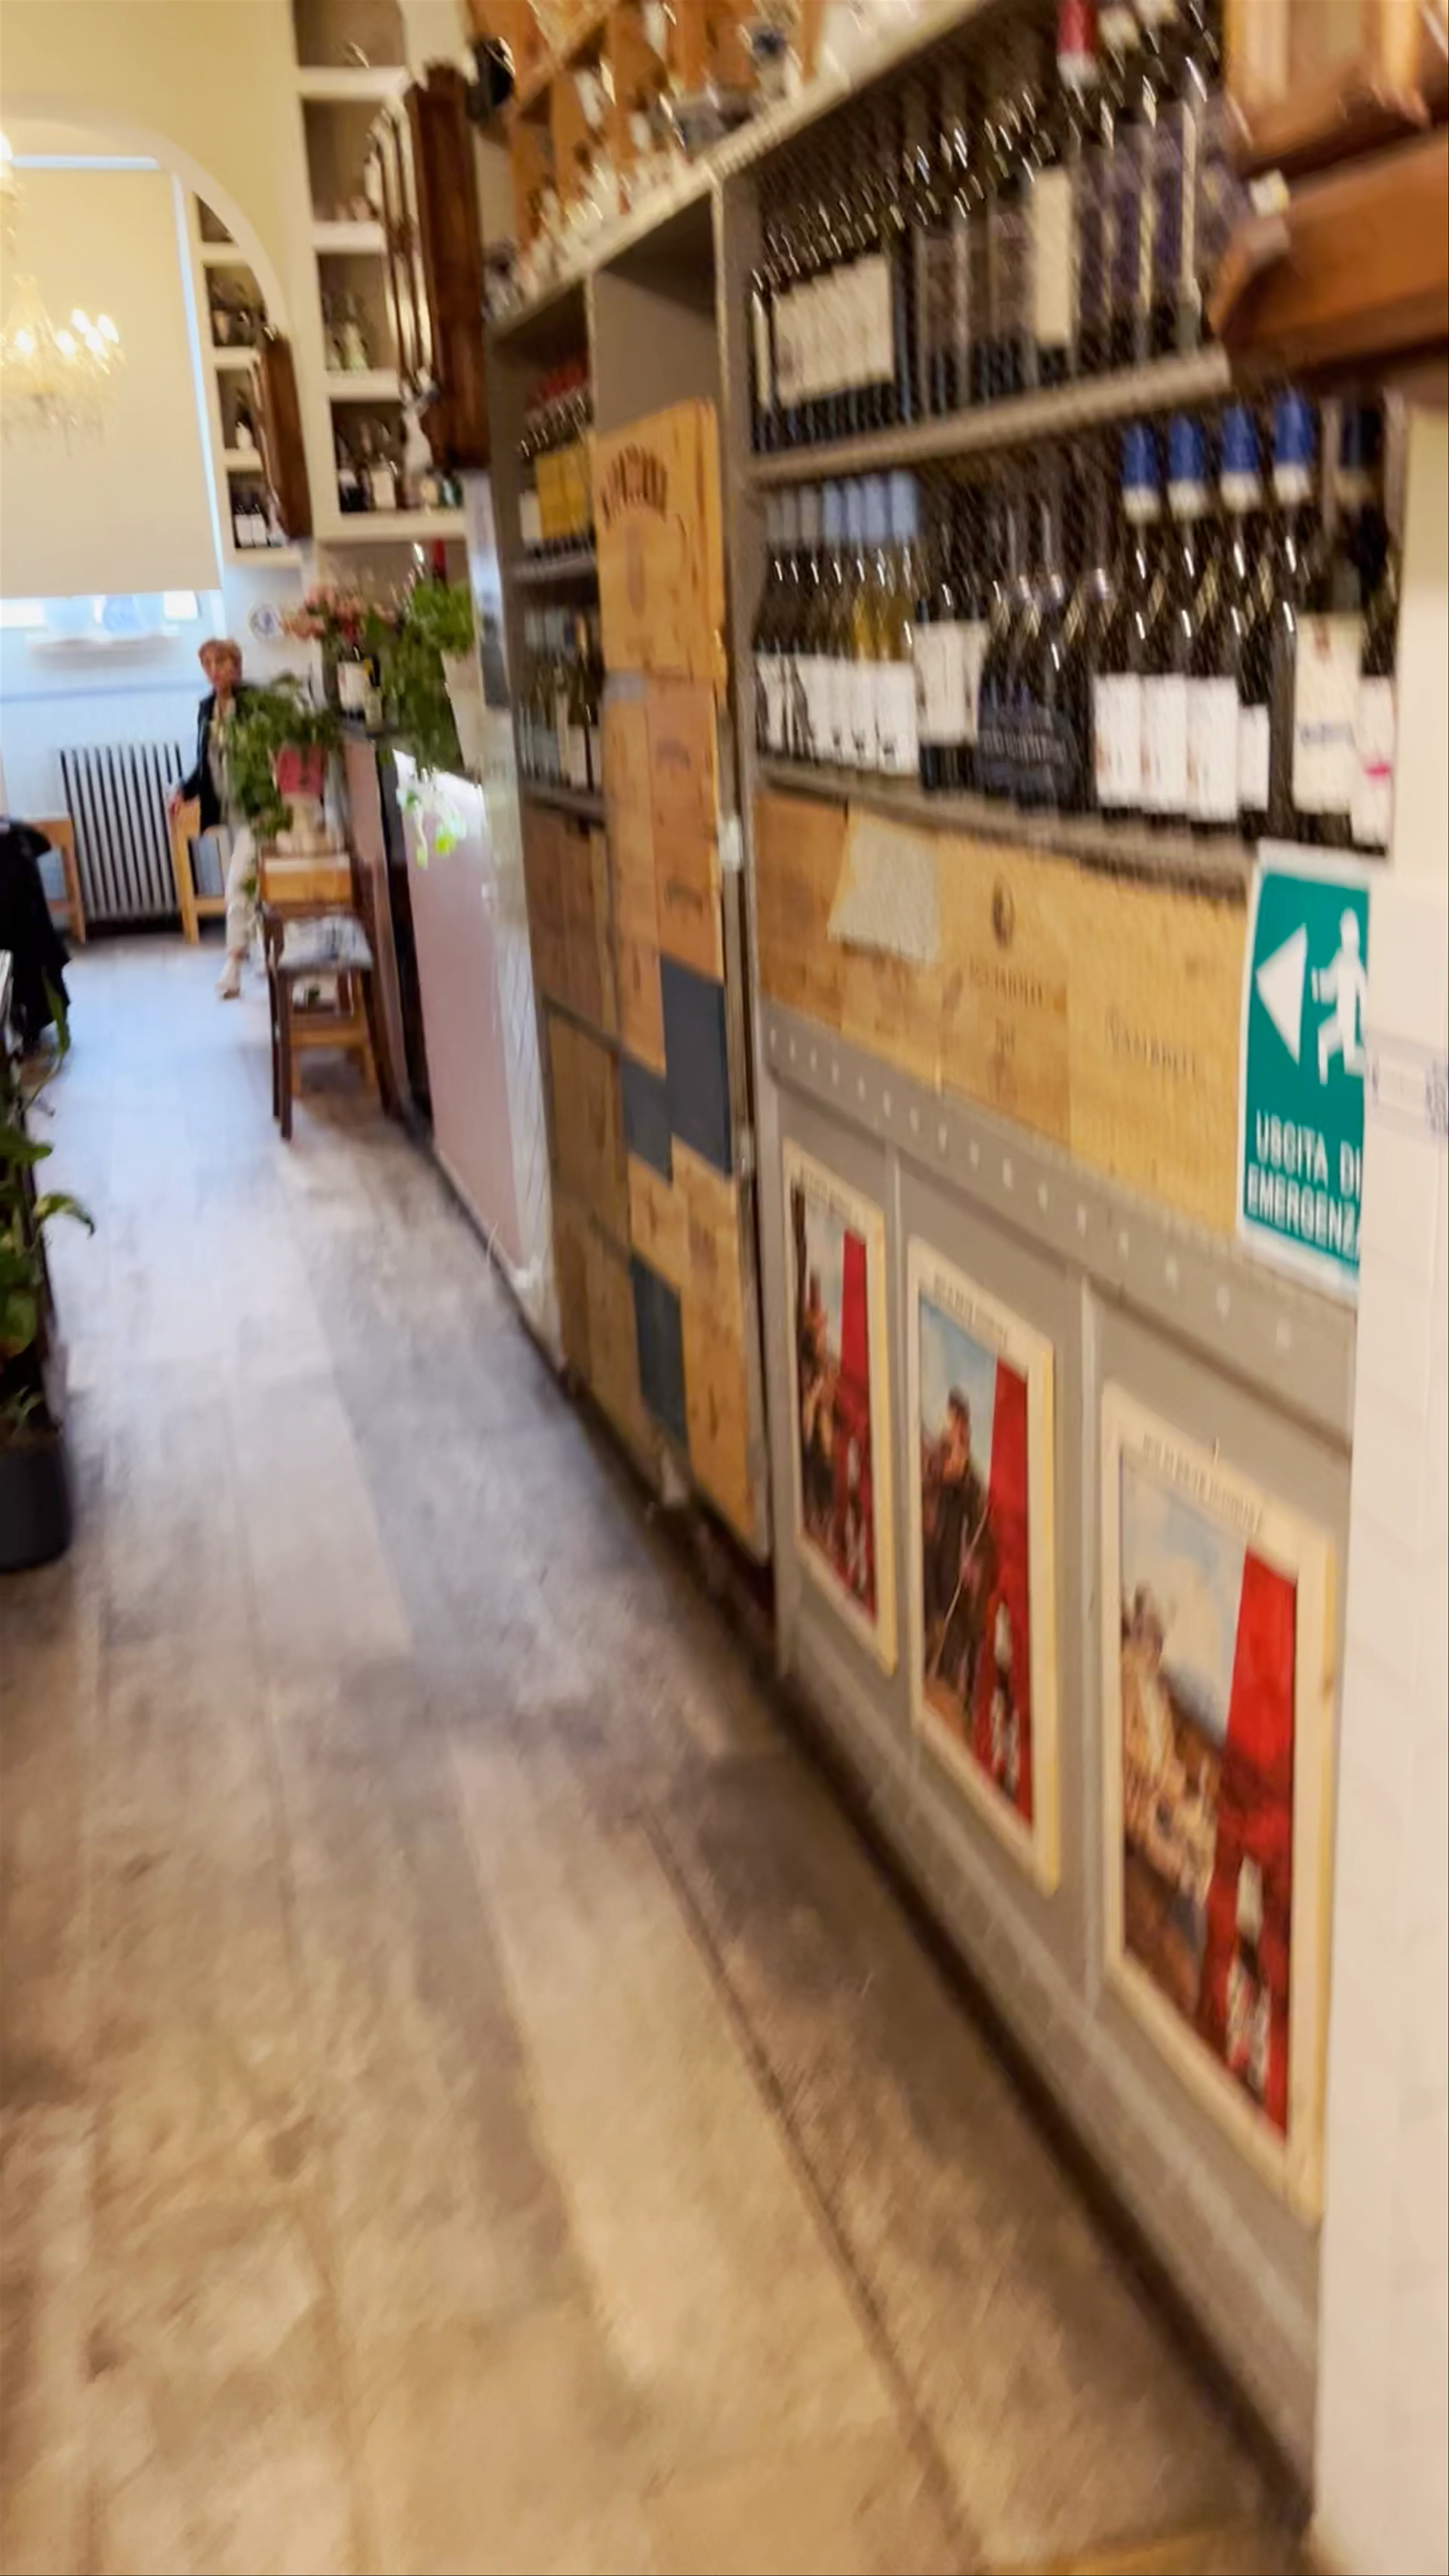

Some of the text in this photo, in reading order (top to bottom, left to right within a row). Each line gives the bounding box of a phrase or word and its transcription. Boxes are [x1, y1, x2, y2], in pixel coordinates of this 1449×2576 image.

[1256, 1108, 1360, 1203] USCITA DI
[1247, 1161, 1357, 1259] EMERGENZ
